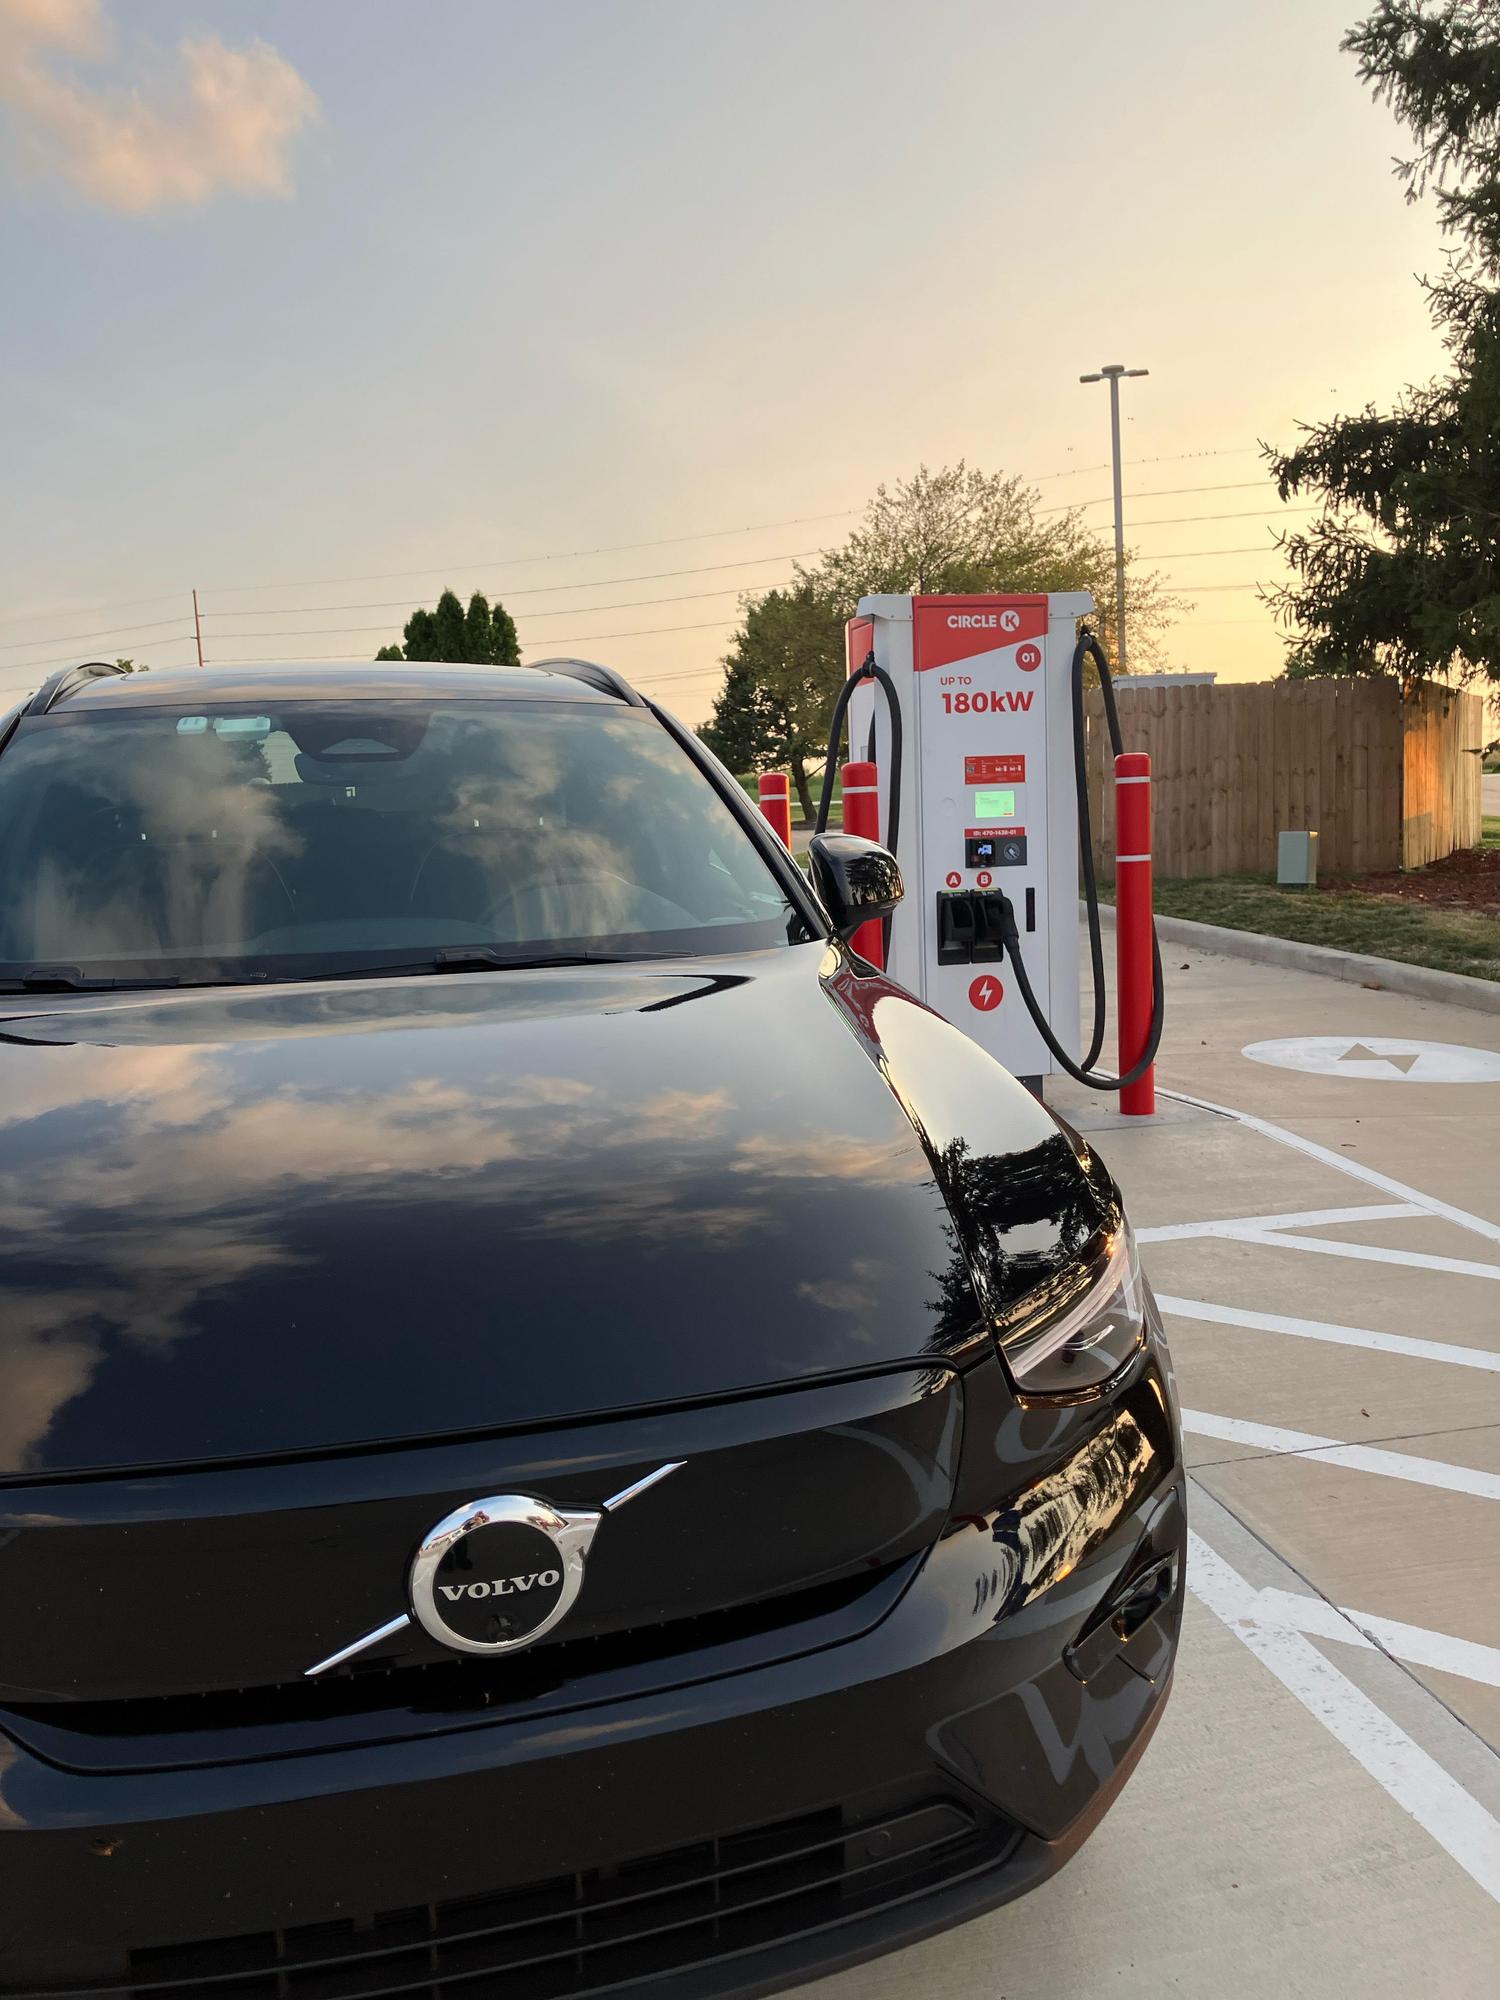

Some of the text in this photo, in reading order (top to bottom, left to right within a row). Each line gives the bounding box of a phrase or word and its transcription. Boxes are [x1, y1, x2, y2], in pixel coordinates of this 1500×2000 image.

[947, 612, 1019, 630] CIRCLE K
[1021, 652, 1035, 663] 01
[940, 676, 972, 686] UP TO
[941, 690, 1035, 714] 180kW
[949, 874, 959, 885] A
[980, 874, 989, 885] B
[438, 1569, 560, 1601] VOLVO
